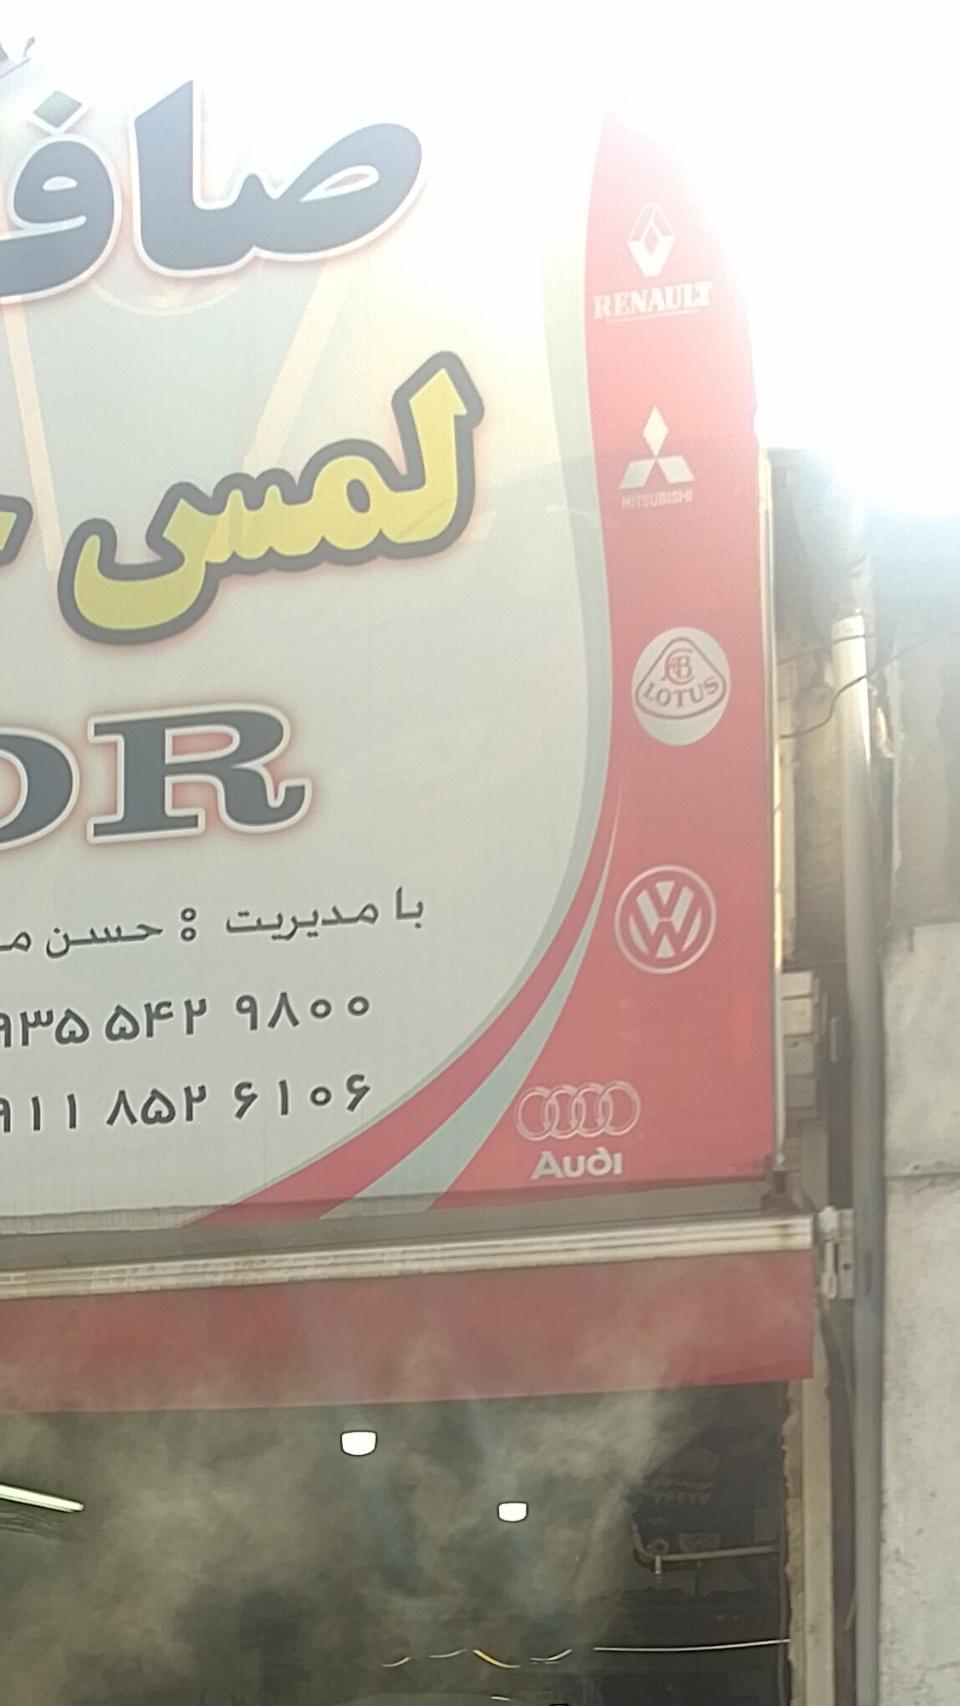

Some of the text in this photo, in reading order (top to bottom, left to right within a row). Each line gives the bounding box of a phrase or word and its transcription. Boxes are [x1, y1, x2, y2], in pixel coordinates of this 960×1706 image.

[593, 280, 713, 320] RENAULT
[58, 350, 484, 645] لمس
[644, 674, 720, 709] LOTUS
[225, 902, 379, 941] مدیریت
[395, 886, 424, 929] با
[44, 921, 164, 959] حسن
[530, 1146, 623, 1181] Audi
